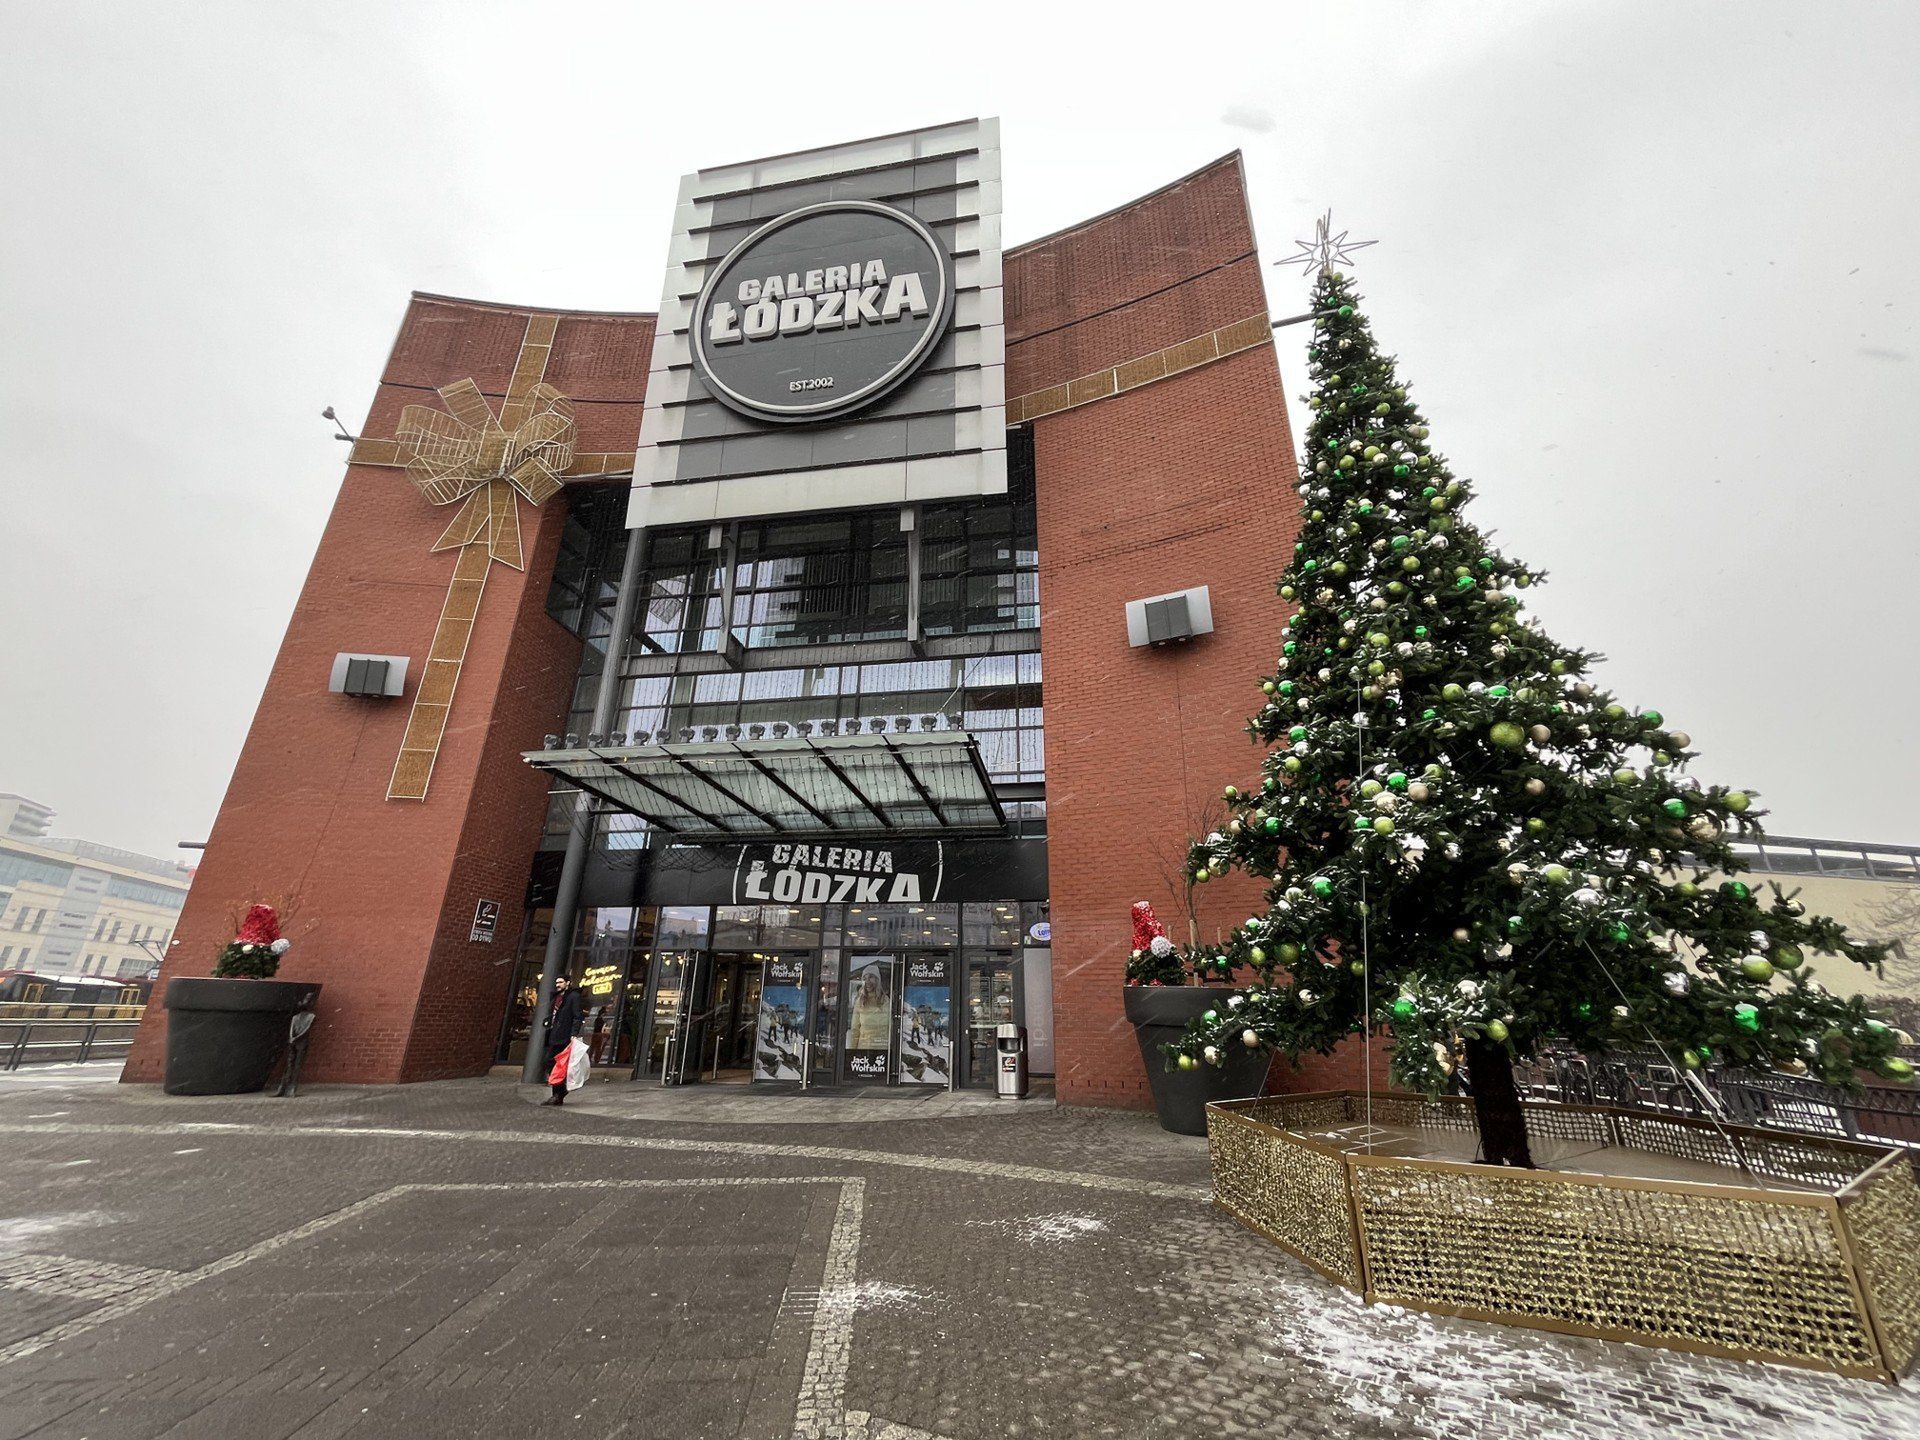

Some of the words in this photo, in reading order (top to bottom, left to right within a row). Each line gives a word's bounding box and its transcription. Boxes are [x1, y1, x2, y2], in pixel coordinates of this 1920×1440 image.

[738, 258, 888, 303] GALERIA
[708, 271, 930, 344] ŁÓDZKA
[771, 844, 893, 873] GALERIA
[745, 860, 921, 903] ŁÓDZKA
[771, 963, 788, 971] Jack
[910, 962, 928, 970] Jack
[771, 969, 801, 978] Wolfskin
[910, 969, 944, 978] Wolfskin
[851, 1056, 869, 1064] Jack
[851, 1063, 886, 1072] Wolfskin
